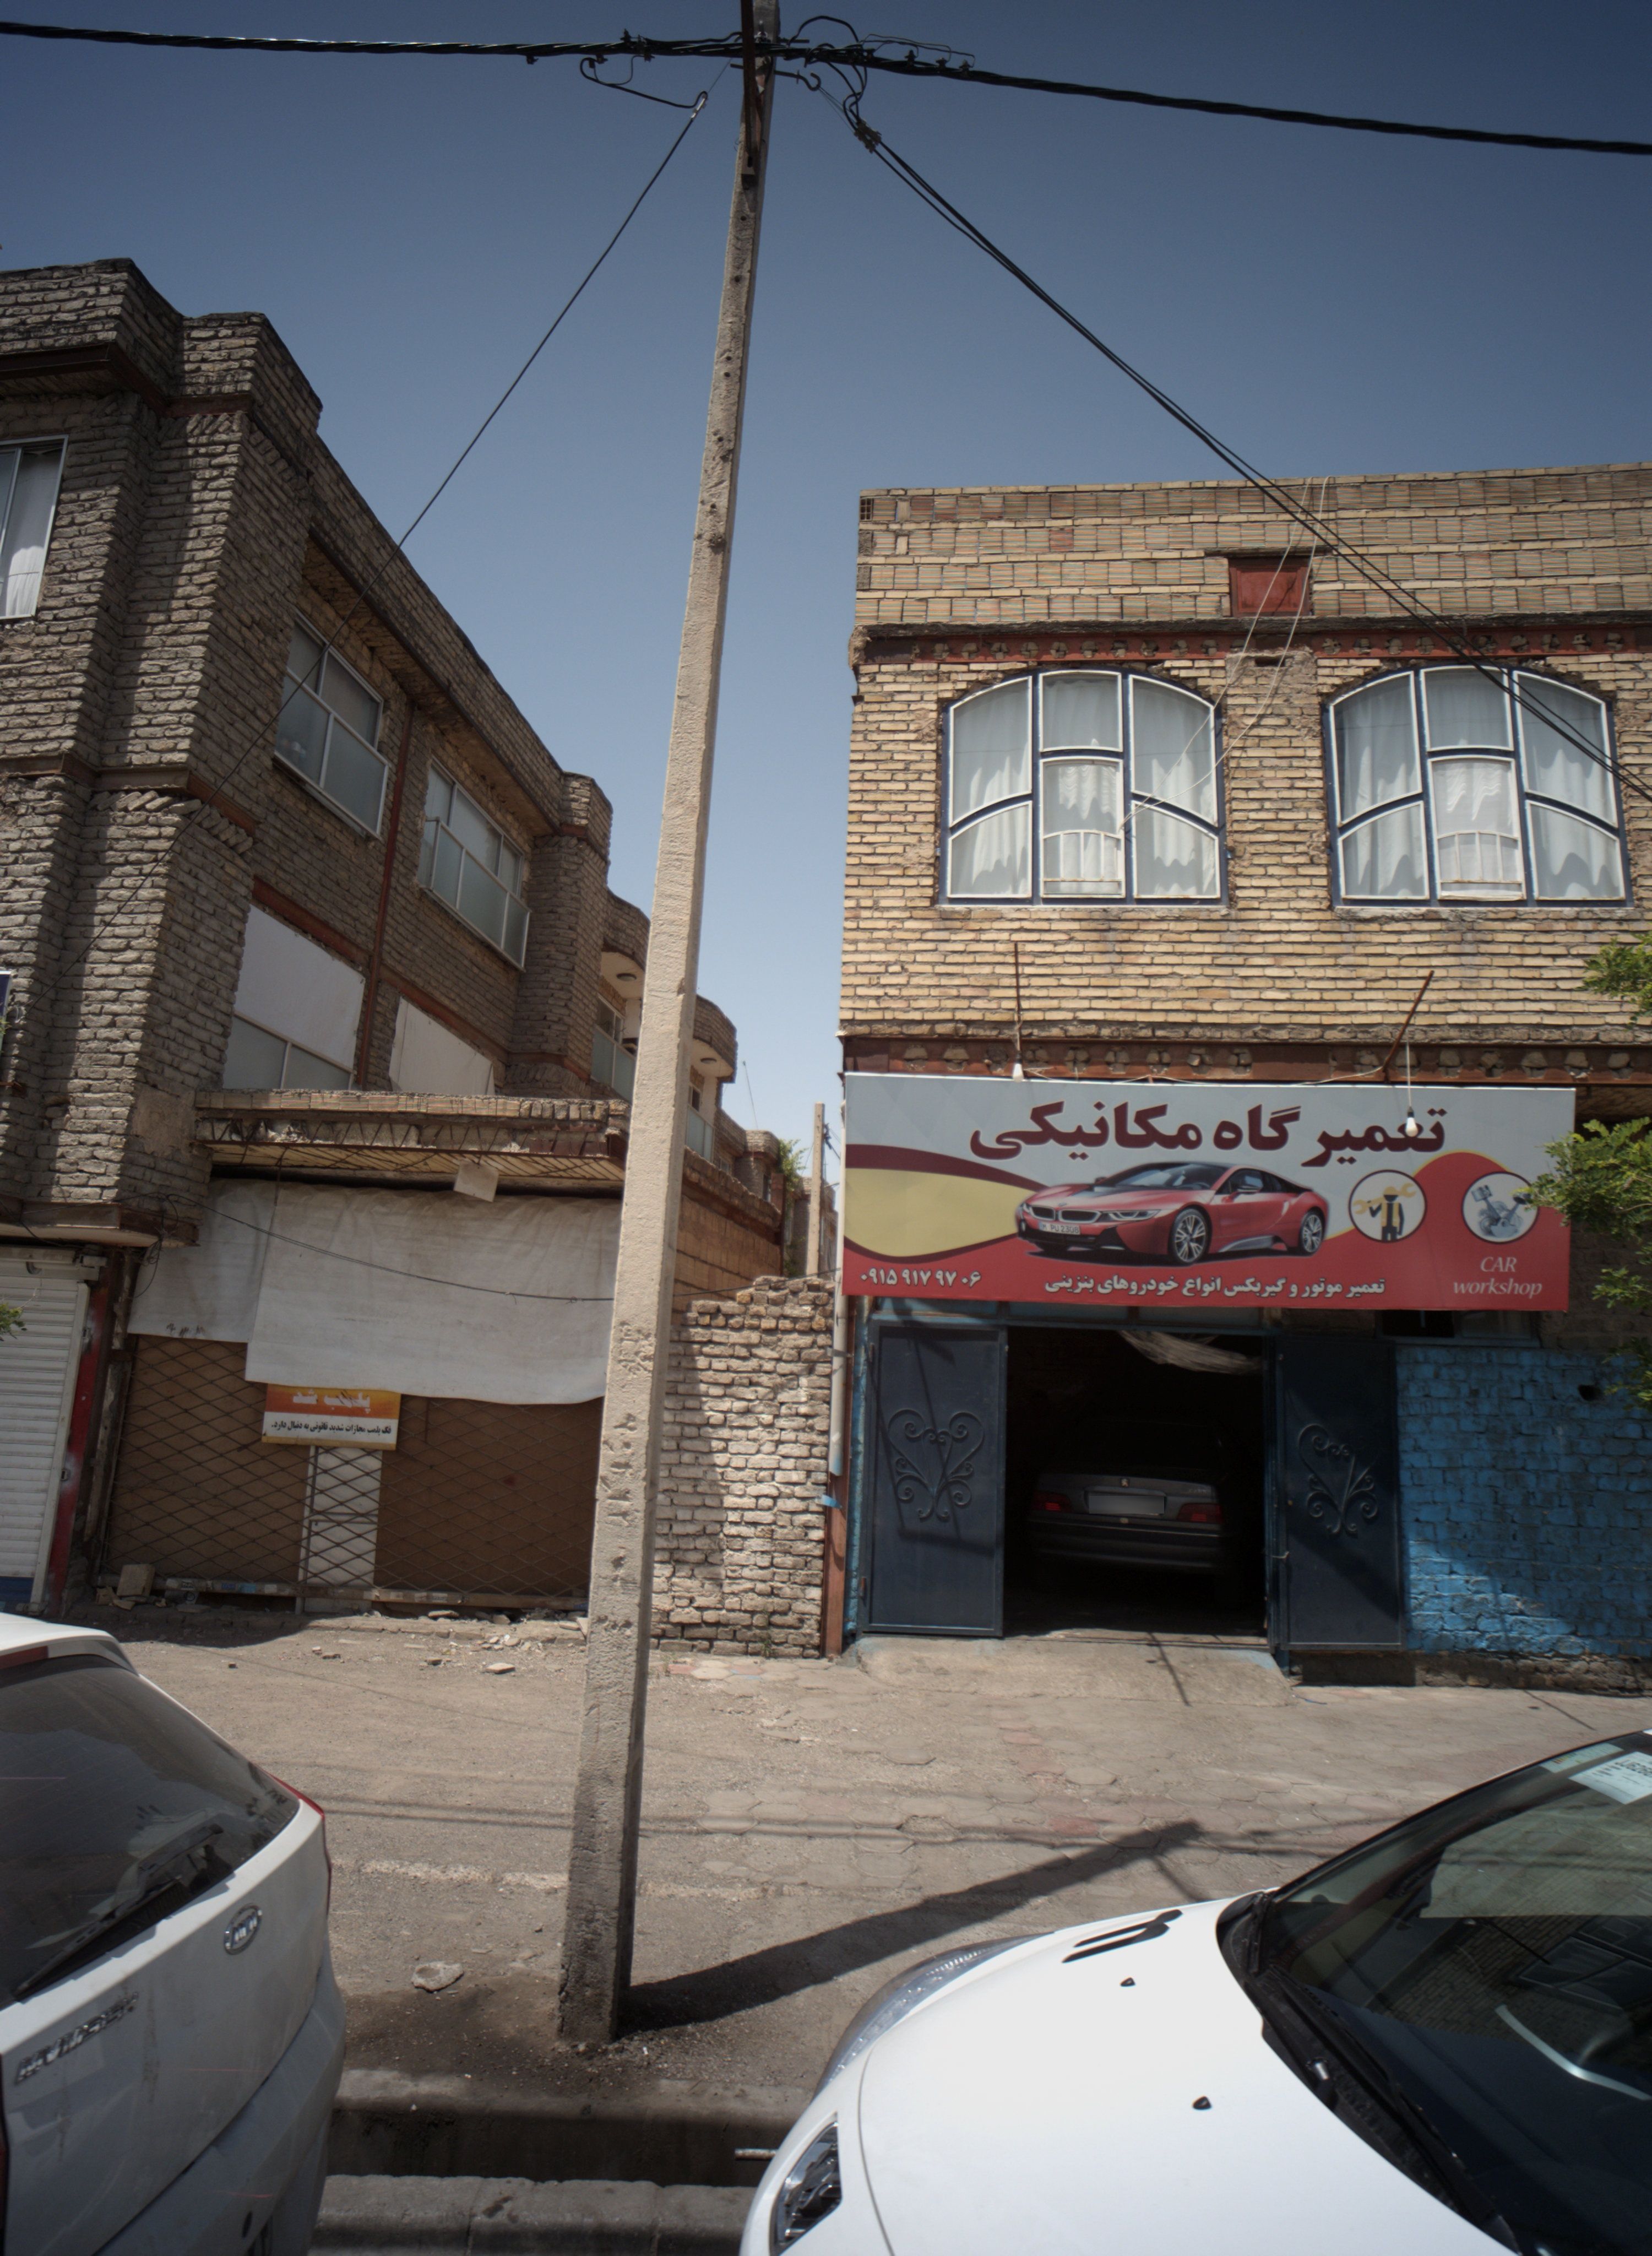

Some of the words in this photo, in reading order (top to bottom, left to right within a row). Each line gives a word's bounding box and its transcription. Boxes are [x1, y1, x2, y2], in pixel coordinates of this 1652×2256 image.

[970, 1100, 1203, 1161] مکانیکی
[1213, 1104, 1301, 1151] گاه
[1301, 1108, 1448, 1167] تعمیر
[1480, 1256, 1517, 1273] CAR
[860, 1267, 898, 1286] ۰۹۱۵
[901, 1268, 932, 1287] ۹۱۷
[935, 1270, 957, 1287] ۹۷
[1044, 1275, 1095, 1293] بنزینی
[1097, 1275, 1179, 1295] خودروهای
[1182, 1276, 1221, 1297] انواع
[1224, 1277, 1286, 1297] گیربکس
[1289, 1283, 1298, 1298] و
[1301, 1277, 1343, 1298] موتور
[1345, 1278, 1385, 1298] تعمیر
[1453, 1277, 1543, 1300] workshop
[292, 1389, 318, 1404] شد
[287, 1420, 302, 1431] دنبال
[309, 1421, 328, 1433] قانونی
[329, 1423, 344, 1433] شدید
[345, 1423, 366, 1435] مجازات
[367, 1425, 381, 1436] پلمب
